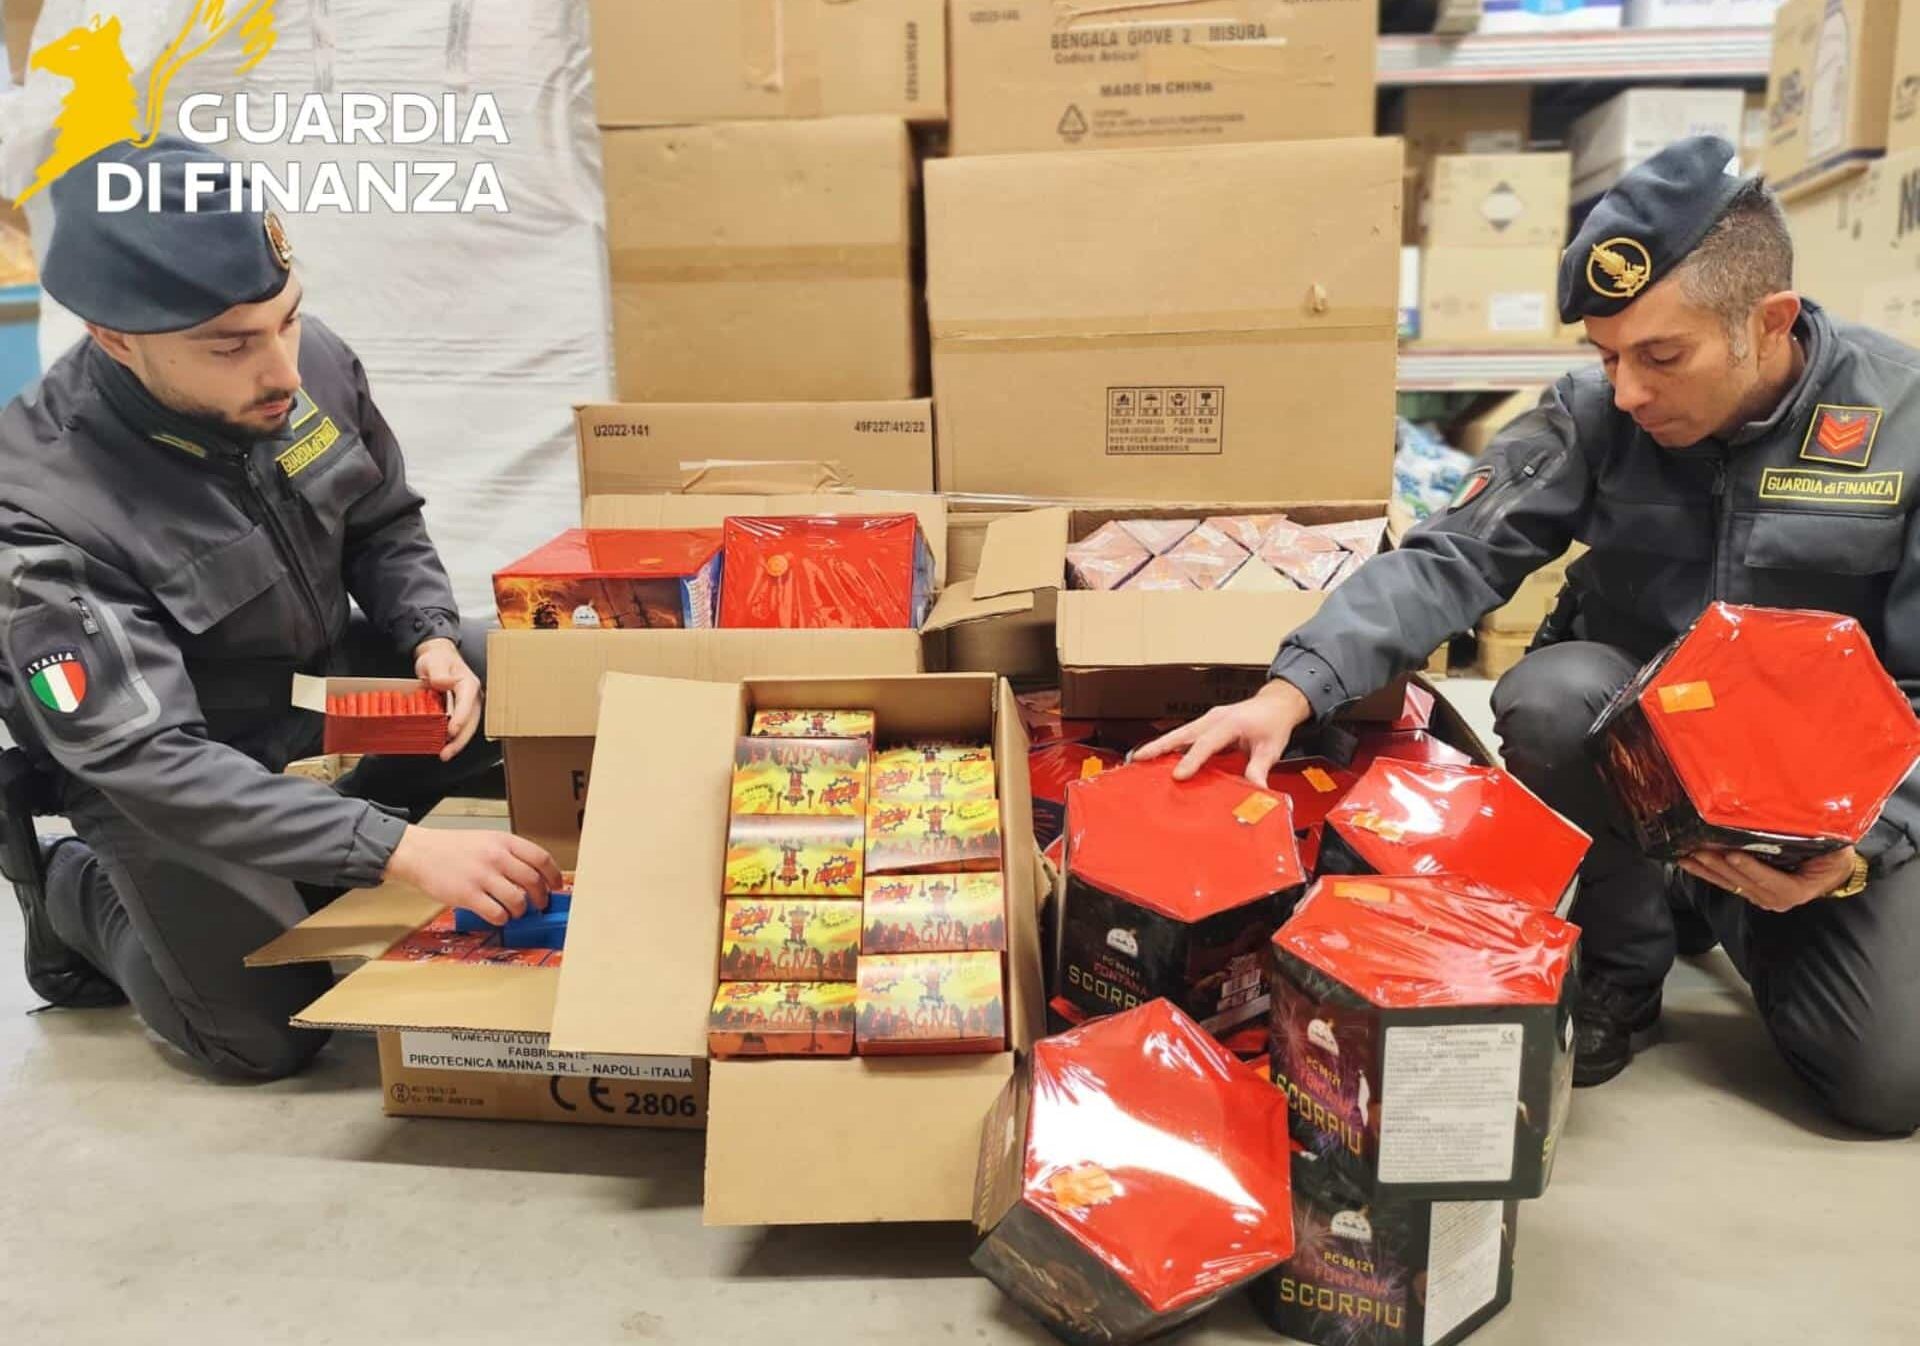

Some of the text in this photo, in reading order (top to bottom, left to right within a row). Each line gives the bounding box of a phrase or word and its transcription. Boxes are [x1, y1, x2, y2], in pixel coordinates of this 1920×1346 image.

[1051, 31, 1118, 49] BENGALA
[1128, 28, 1172, 46] GIOVE
[1101, 81, 1213, 97] MADE IN CHINA
[594, 424, 649, 437] U2022-141
[1767, 476, 1894, 495] GUARDIA di FINANZA
[27, 651, 75, 675] ITALIA
[1068, 963, 1143, 1009] SCORP
[409, 1054, 495, 1069] PIROTECNICA
[497, 1058, 543, 1071] MANNA
[592, 1063, 640, 1077] NAPOLI
[651, 1066, 693, 1079] ITALIA
[624, 1092, 697, 1117] 2806
[1276, 1073, 1362, 1155] SCORPIU
[1323, 1251, 1340, 1264] PC
[1279, 1278, 1402, 1328] SCORPIU
